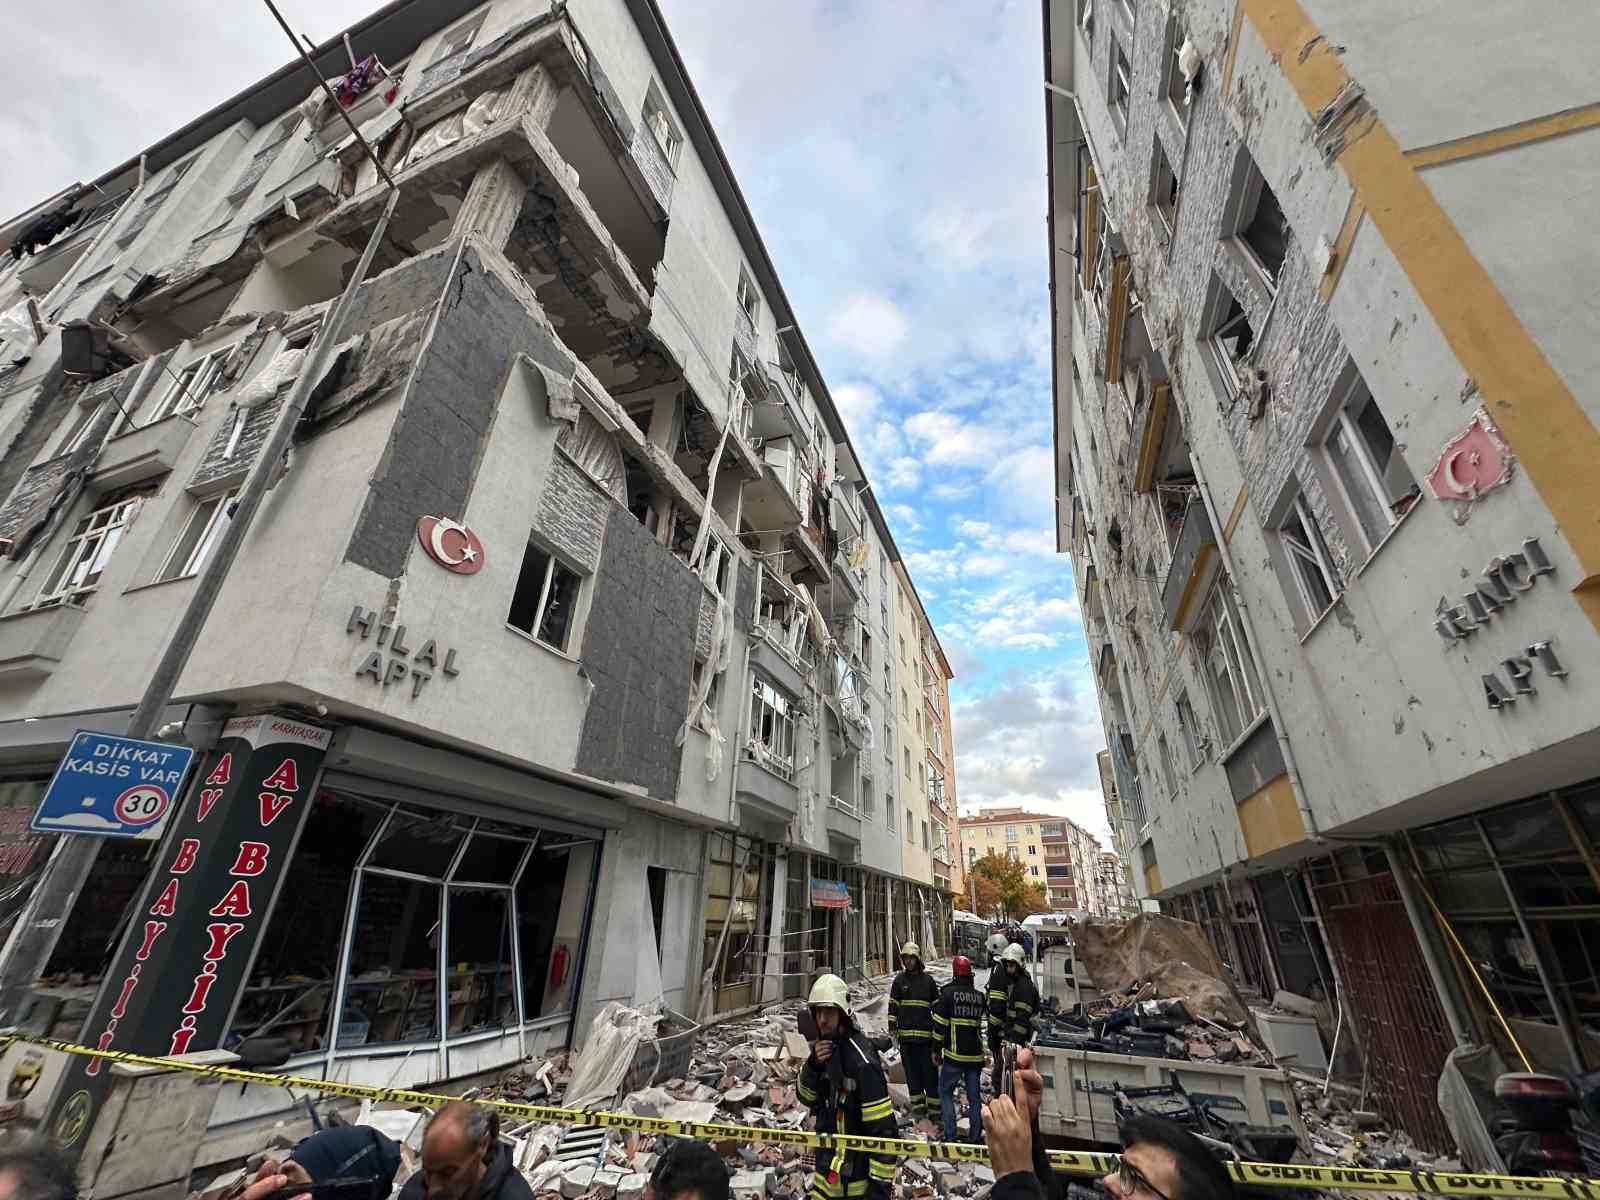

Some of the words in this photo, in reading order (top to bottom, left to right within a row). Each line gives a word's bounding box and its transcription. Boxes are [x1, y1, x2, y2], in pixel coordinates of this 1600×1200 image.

[356, 651, 432, 700] APT
[1481, 640, 1568, 709] APT
[64, 758, 131, 777] KASİS
[139, 766, 181, 784] VAR
[94, 743, 173, 766] DİKKAT
[124, 795, 158, 814] 30
[197, 753, 232, 822] AV
[260, 758, 299, 827] AV
